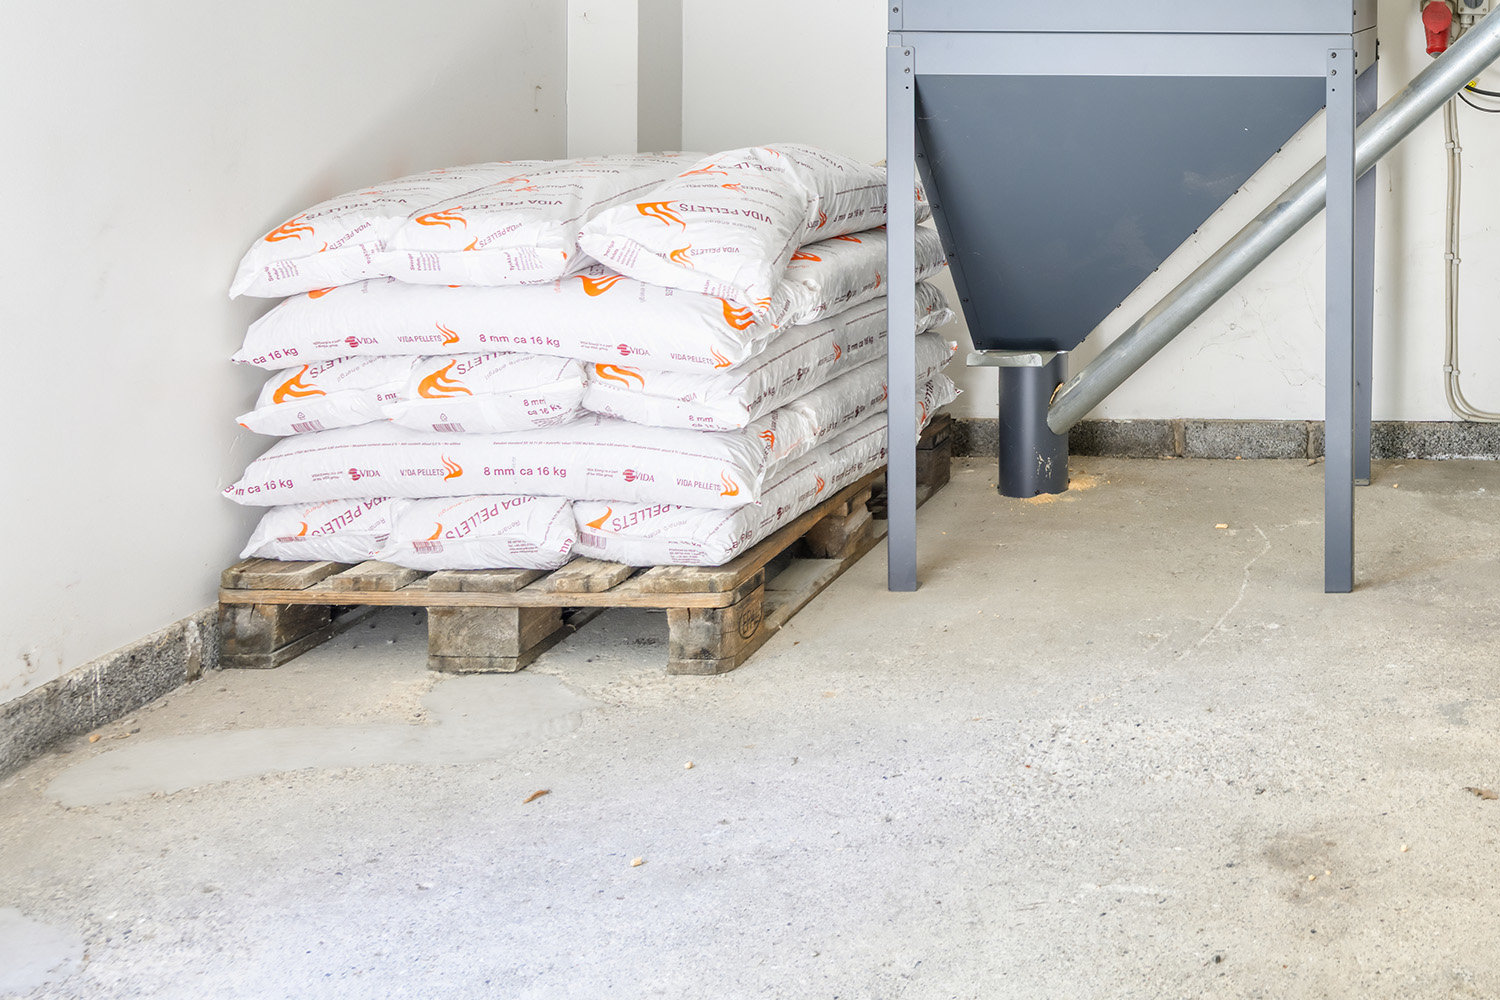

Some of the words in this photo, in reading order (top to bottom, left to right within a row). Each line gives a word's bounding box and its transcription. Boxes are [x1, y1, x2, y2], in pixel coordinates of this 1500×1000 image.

[679, 203, 739, 216] PELLETS
[741, 208, 773, 225] VIDA
[690, 246, 721, 256] PELLETS
[356, 337, 379, 345] VIDA
[414, 334, 442, 343] PELLETS
[479, 334, 486, 343] 8
[489, 335, 510, 343] mm
[531, 336, 543, 345] 16
[546, 337, 561, 348] kg
[253, 356, 267, 365] ca
[268, 350, 282, 361] 16
[282, 347, 299, 358] kg
[629, 346, 651, 357] VIDA
[670, 353, 687, 361] VIDA
[687, 354, 715, 366] PELLETS
[523, 399, 529, 407] 8
[530, 398, 546, 406] mm
[358, 469, 381, 478] VIDA
[400, 469, 417, 477] VIDA
[417, 468, 445, 477] PELLETS
[483, 467, 491, 476] 8
[493, 468, 515, 476] mm
[519, 468, 533, 476] ca
[537, 467, 550, 476] 16
[553, 466, 567, 478] kg
[635, 472, 655, 483] VIDA
[247, 485, 261, 494] ca
[264, 480, 277, 491] 16
[279, 479, 293, 489] kg
[676, 478, 693, 488] VIDA
[693, 480, 721, 491] PELLETS
[445, 503, 500, 540] PELLETS
[612, 503, 671, 532] PELLETS
